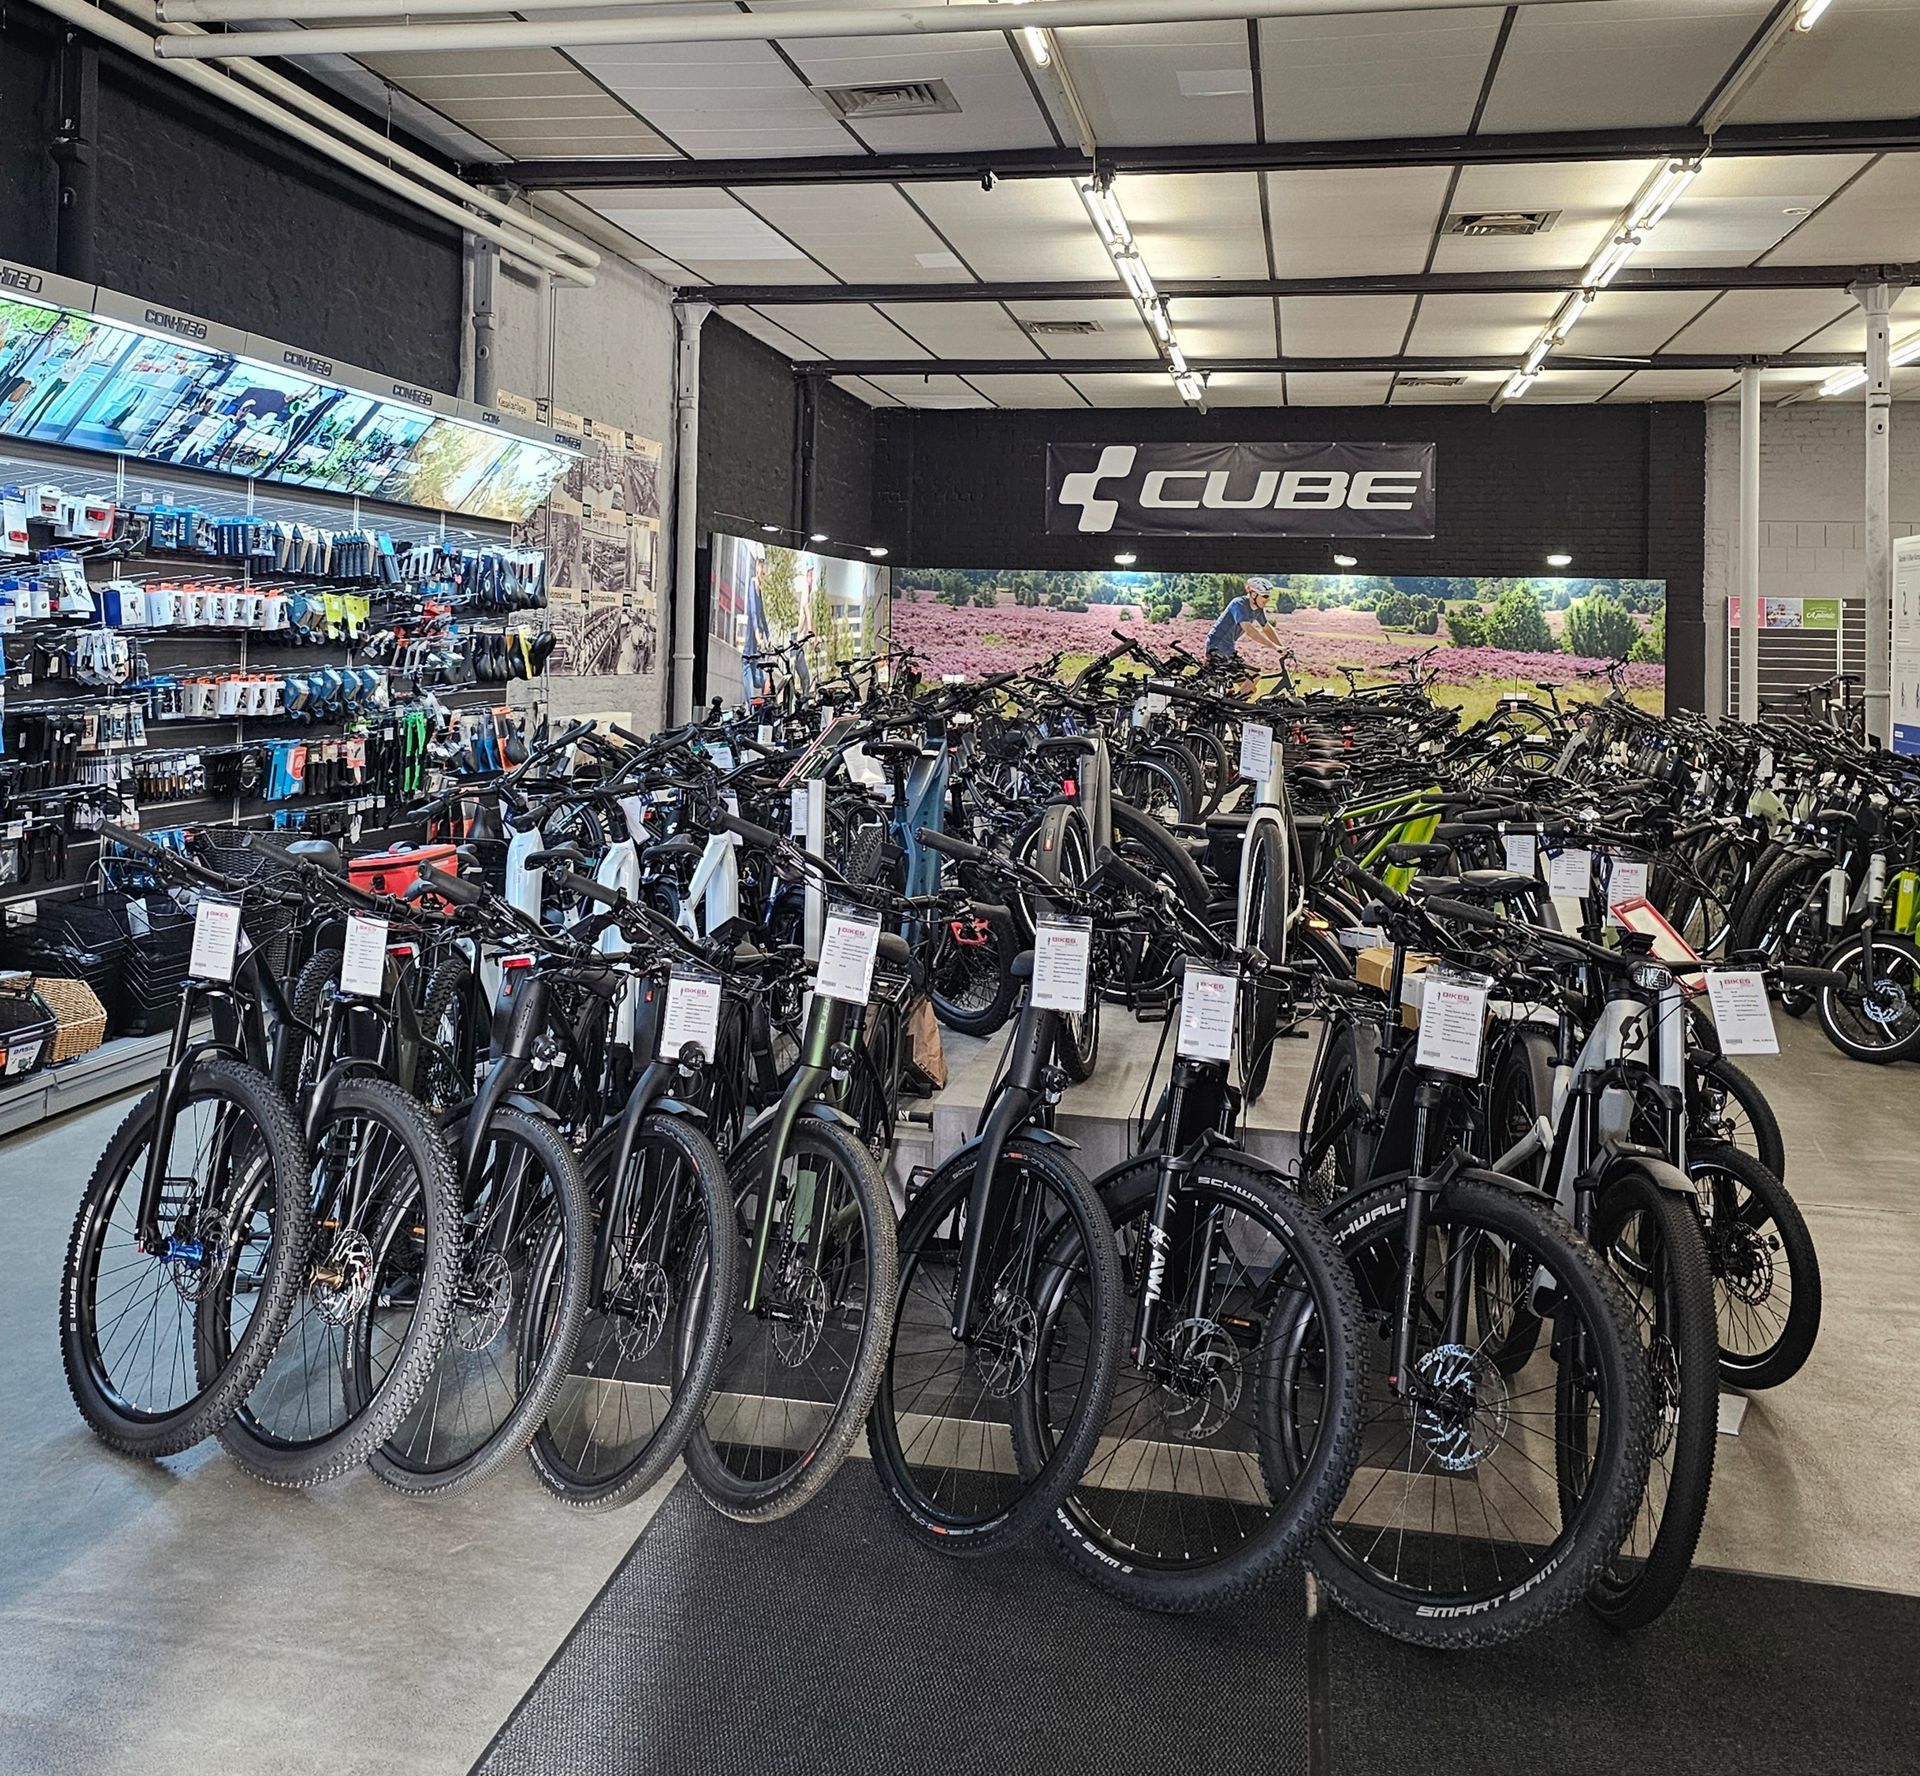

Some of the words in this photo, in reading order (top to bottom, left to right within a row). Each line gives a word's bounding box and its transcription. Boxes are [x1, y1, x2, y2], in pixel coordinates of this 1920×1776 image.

[1138, 470, 1422, 511] CUBE
[1197, 1176, 1295, 1238] SCHWALBE
[1082, 1541, 1121, 1569] SAM
[1415, 1594, 1505, 1618] SMART
[1509, 1558, 1558, 1602] SAM
